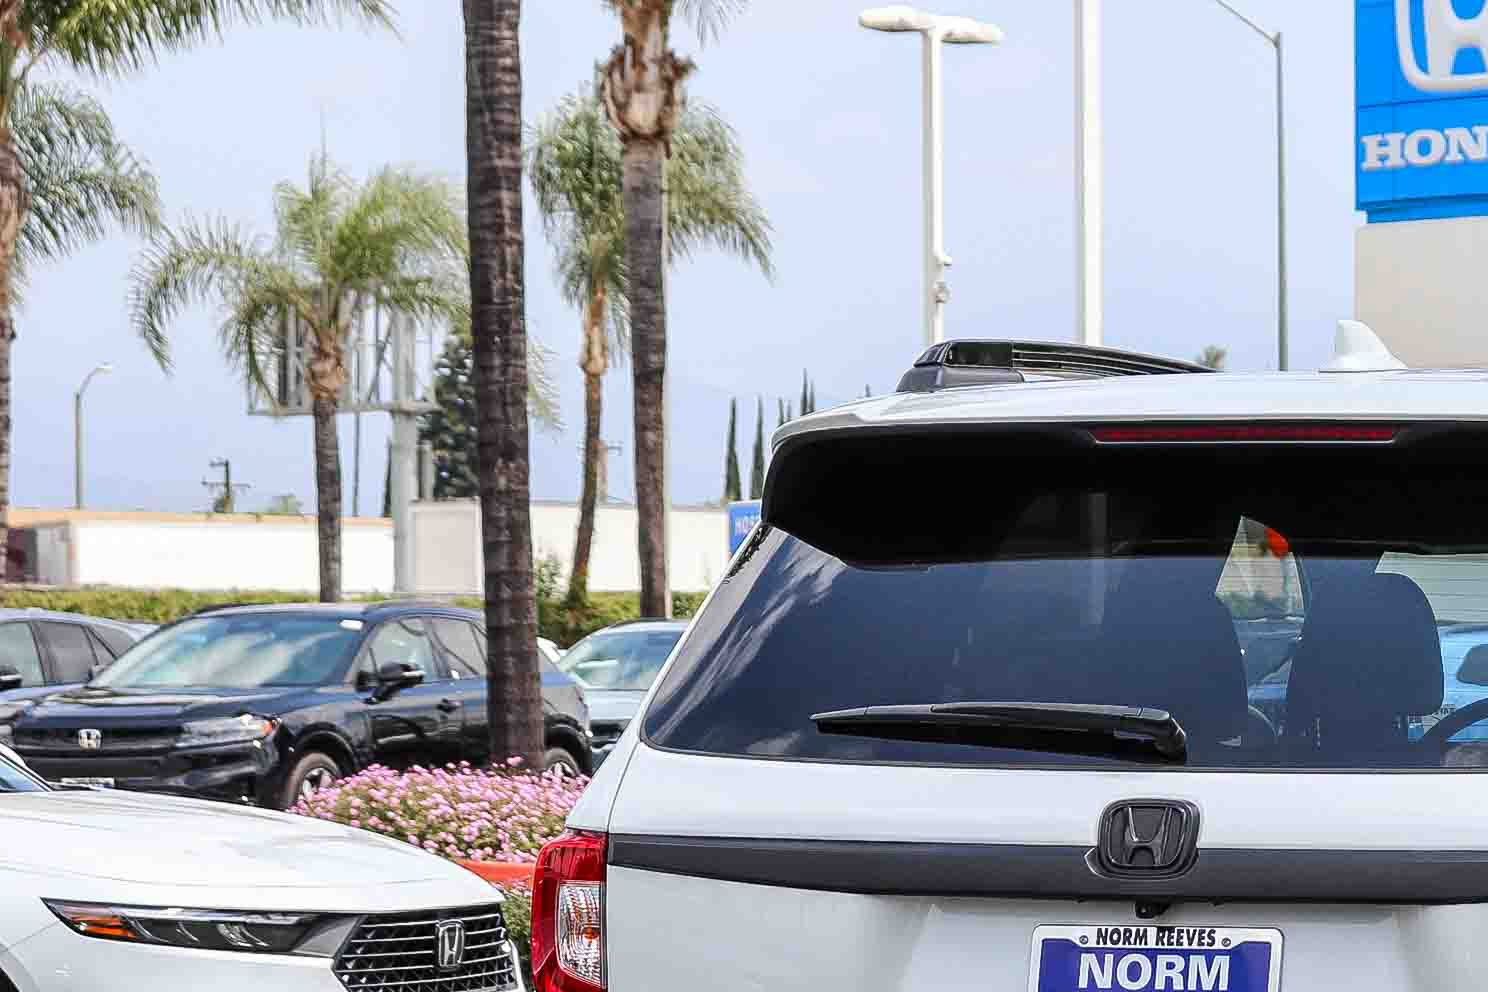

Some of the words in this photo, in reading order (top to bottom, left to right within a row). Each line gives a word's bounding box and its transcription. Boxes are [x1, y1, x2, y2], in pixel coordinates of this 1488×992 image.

[1096, 927, 1148, 946] NORM
[1155, 928, 1216, 947] REEVES
[1078, 953, 1230, 991] NORM
